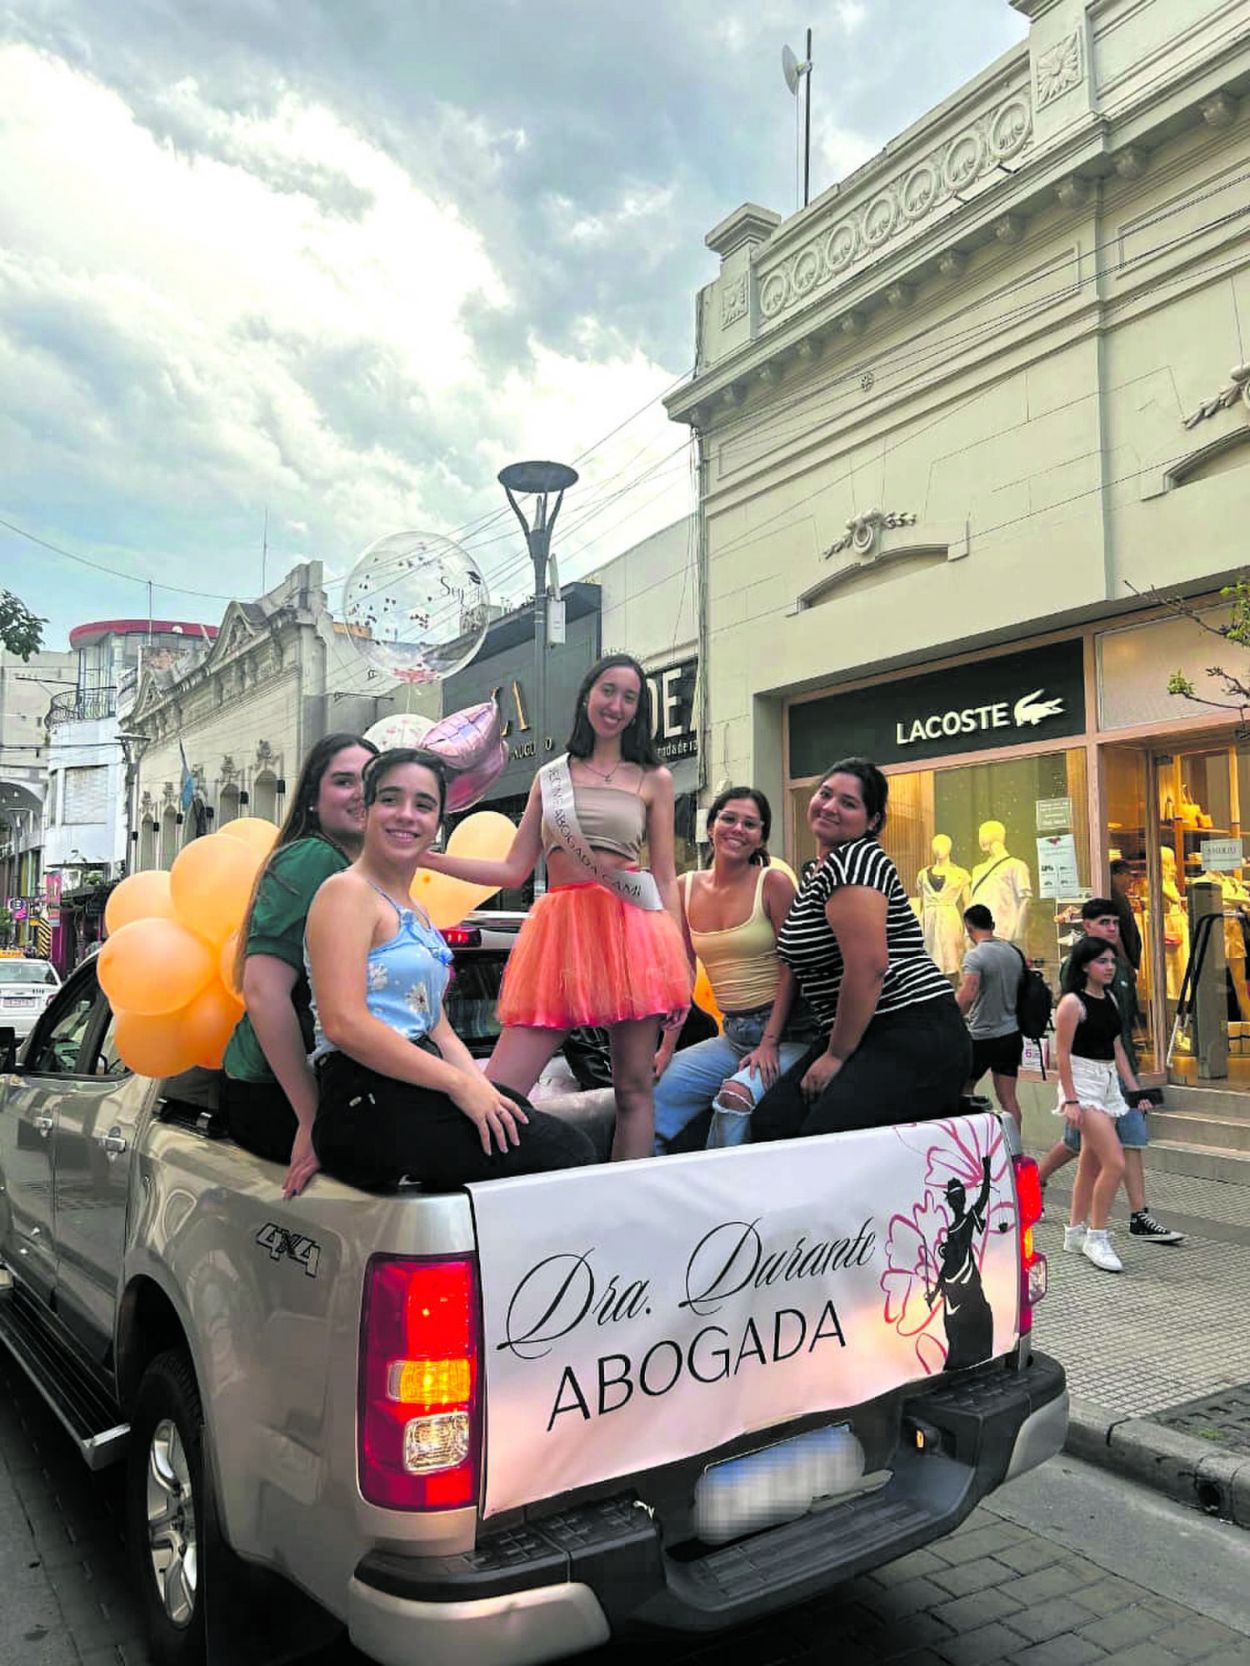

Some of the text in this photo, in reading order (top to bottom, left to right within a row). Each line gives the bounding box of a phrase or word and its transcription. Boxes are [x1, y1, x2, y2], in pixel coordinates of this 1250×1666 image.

[896, 702, 1011, 745] LACOSTE
[555, 808, 598, 875] ABOGADA
[496, 1216, 876, 1360] Dra. Durante
[546, 1299, 847, 1432] ABOGADA
